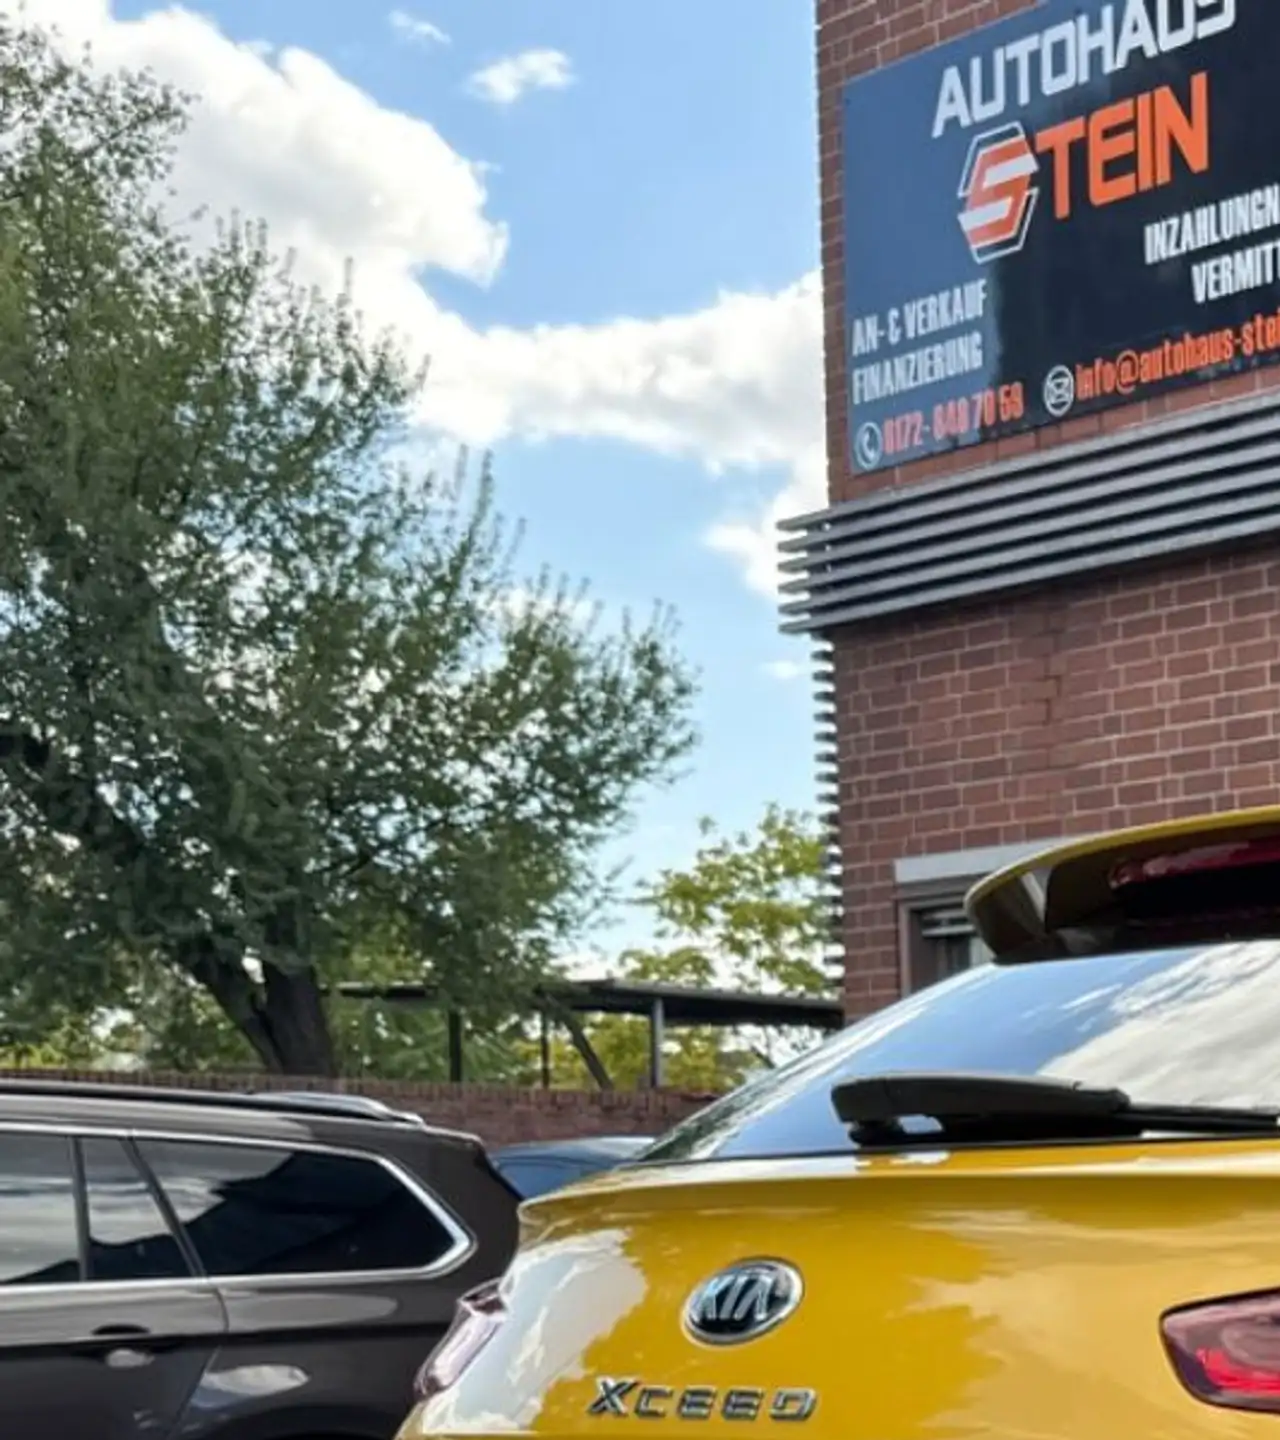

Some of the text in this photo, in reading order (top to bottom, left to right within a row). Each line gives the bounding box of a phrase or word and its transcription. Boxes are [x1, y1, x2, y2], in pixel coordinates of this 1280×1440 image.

[931, 0, 1238, 138] AUTOHAUS
[959, 71, 1209, 262] STEIN
[852, 314, 885, 357] AN-
[903, 278, 987, 339] VERKAUF
[852, 331, 983, 405] FINANZIERUNG
